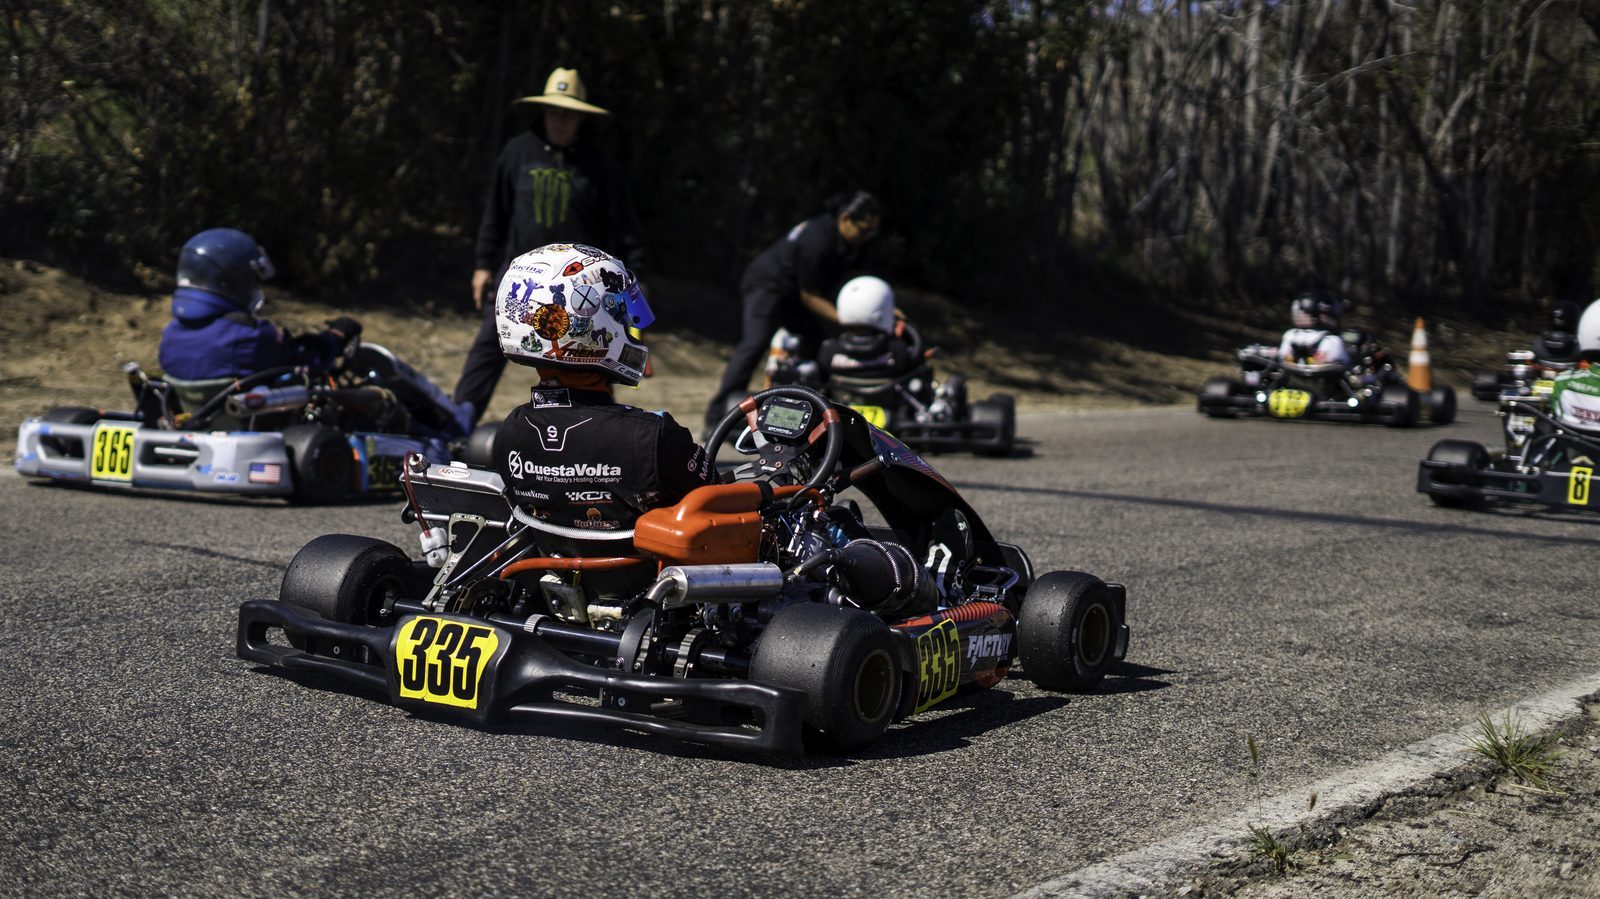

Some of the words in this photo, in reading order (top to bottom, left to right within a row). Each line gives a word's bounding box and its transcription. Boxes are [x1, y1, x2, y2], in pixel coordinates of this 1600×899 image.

[95, 430, 133, 474] 365
[524, 461, 621, 477] QuestaVolta
[1573, 470, 1586, 500] 8
[403, 618, 492, 701] 335
[917, 620, 959, 707] 335
